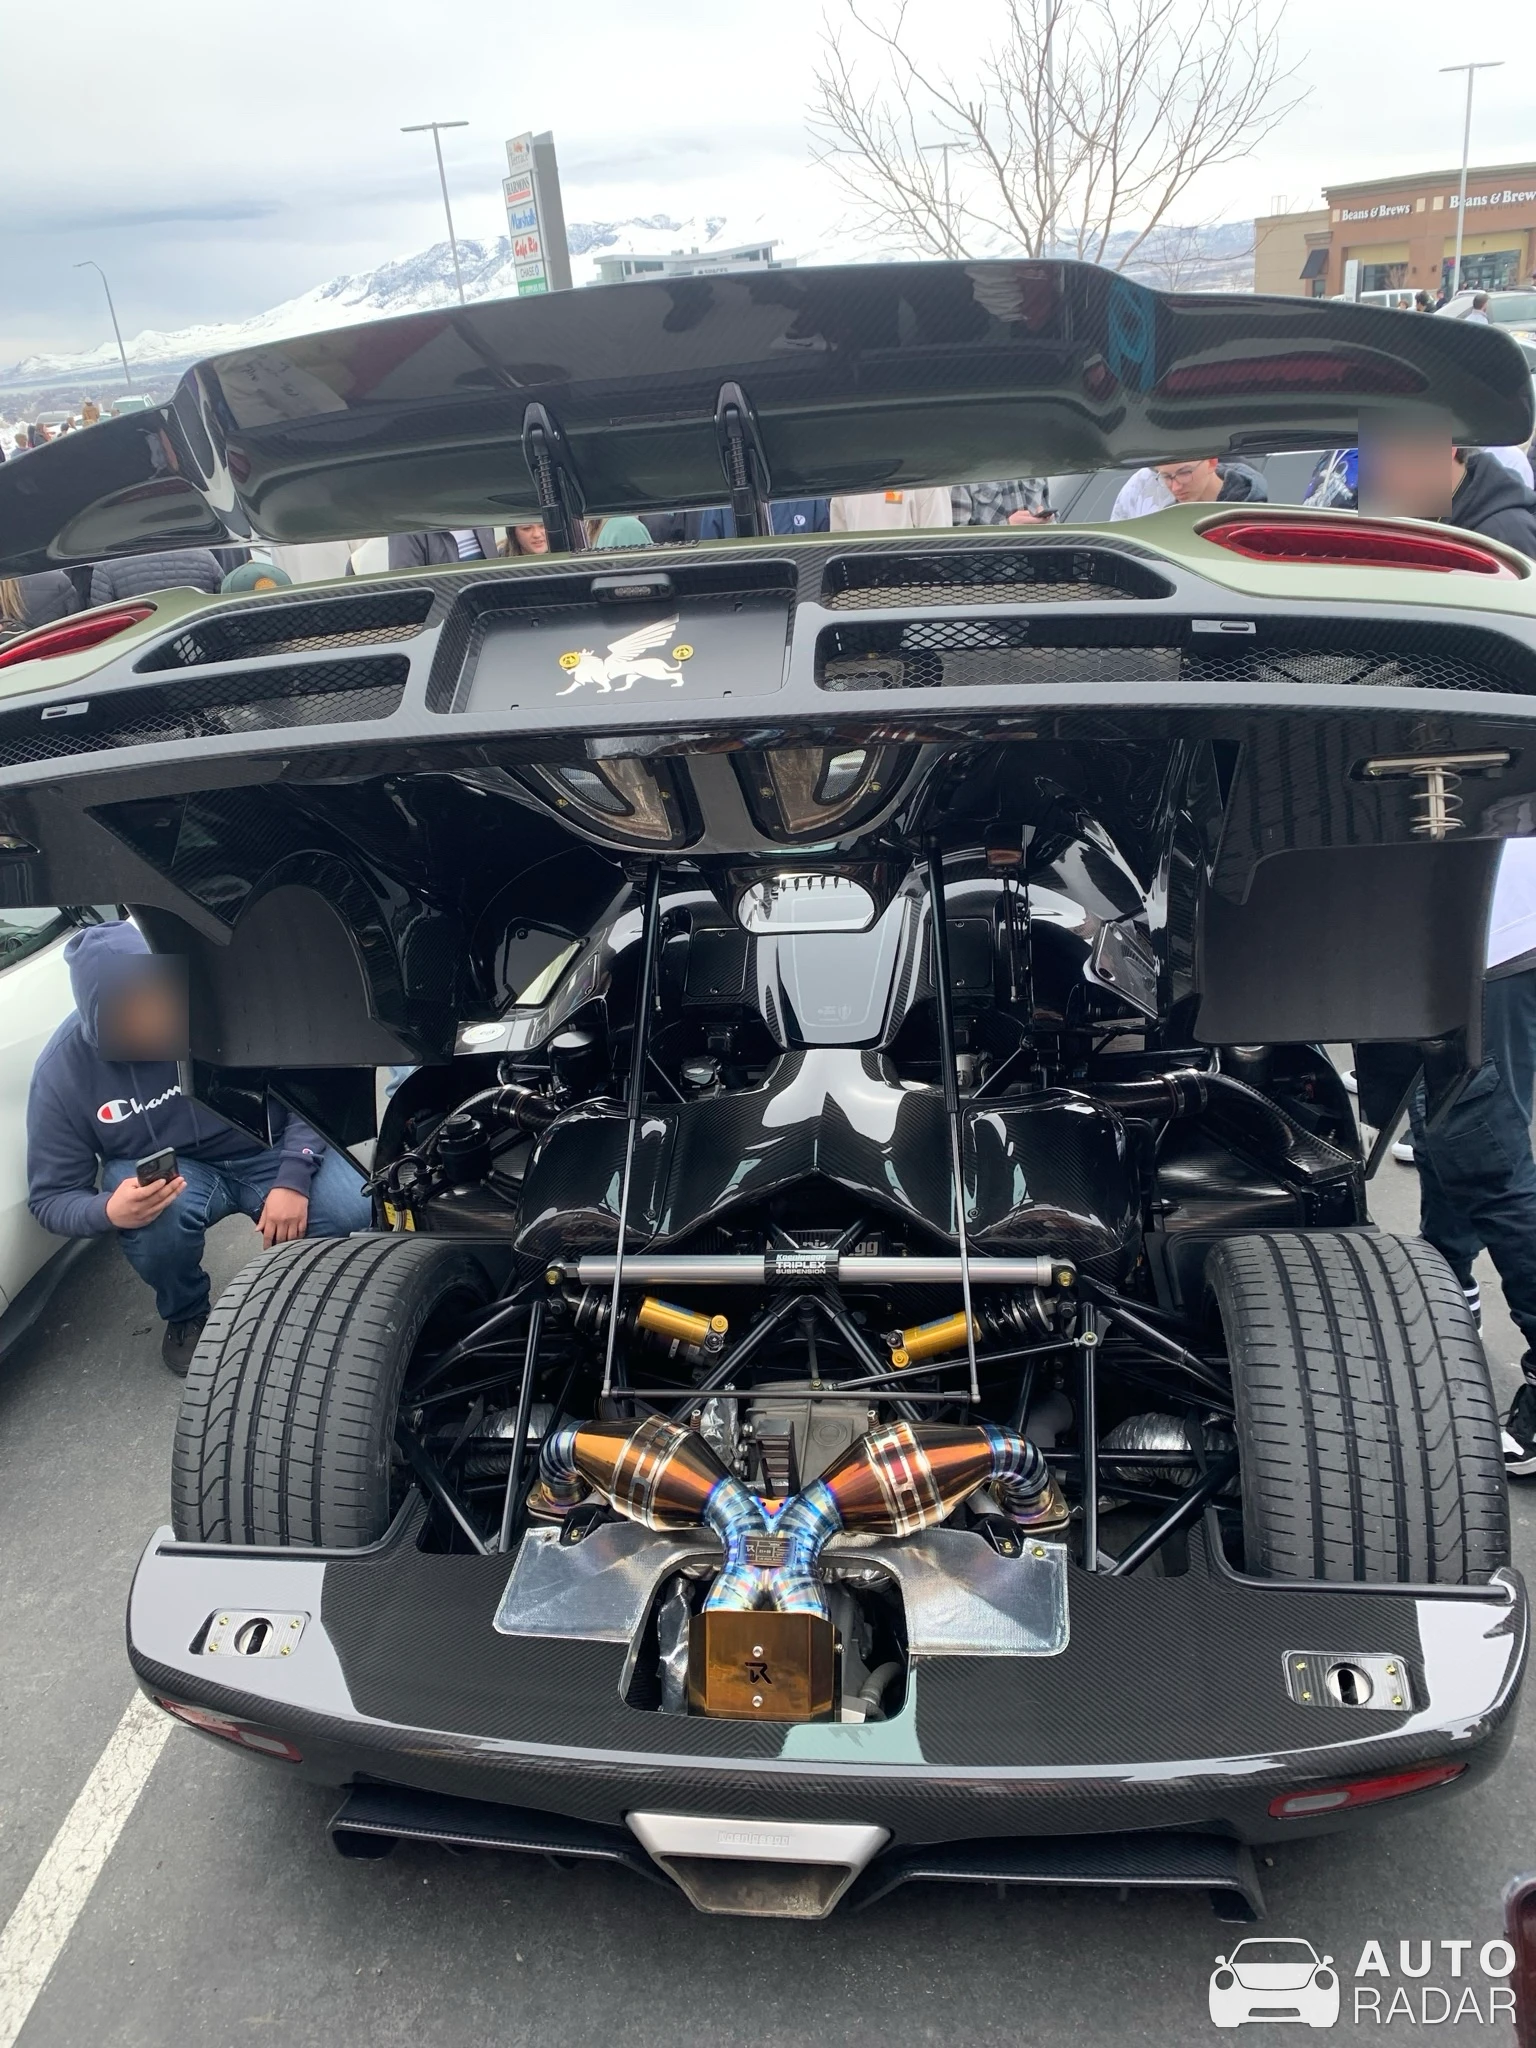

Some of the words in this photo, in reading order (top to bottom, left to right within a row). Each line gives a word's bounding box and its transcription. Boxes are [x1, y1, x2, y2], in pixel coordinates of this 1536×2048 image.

[506, 176, 530, 196] HARMONS
[1449, 195, 1488, 209] Bans
[1490, 193, 1502, 204] &
[1502, 190, 1536, 203] Brew
[1342, 209, 1369, 221] Beans
[1370, 207, 1379, 217] &
[1379, 204, 1411, 217] Brews
[520, 265, 535, 278] CHASE
[97, 1085, 181, 1123] Cham
[776, 1261, 826, 1269] TRIPLEX
